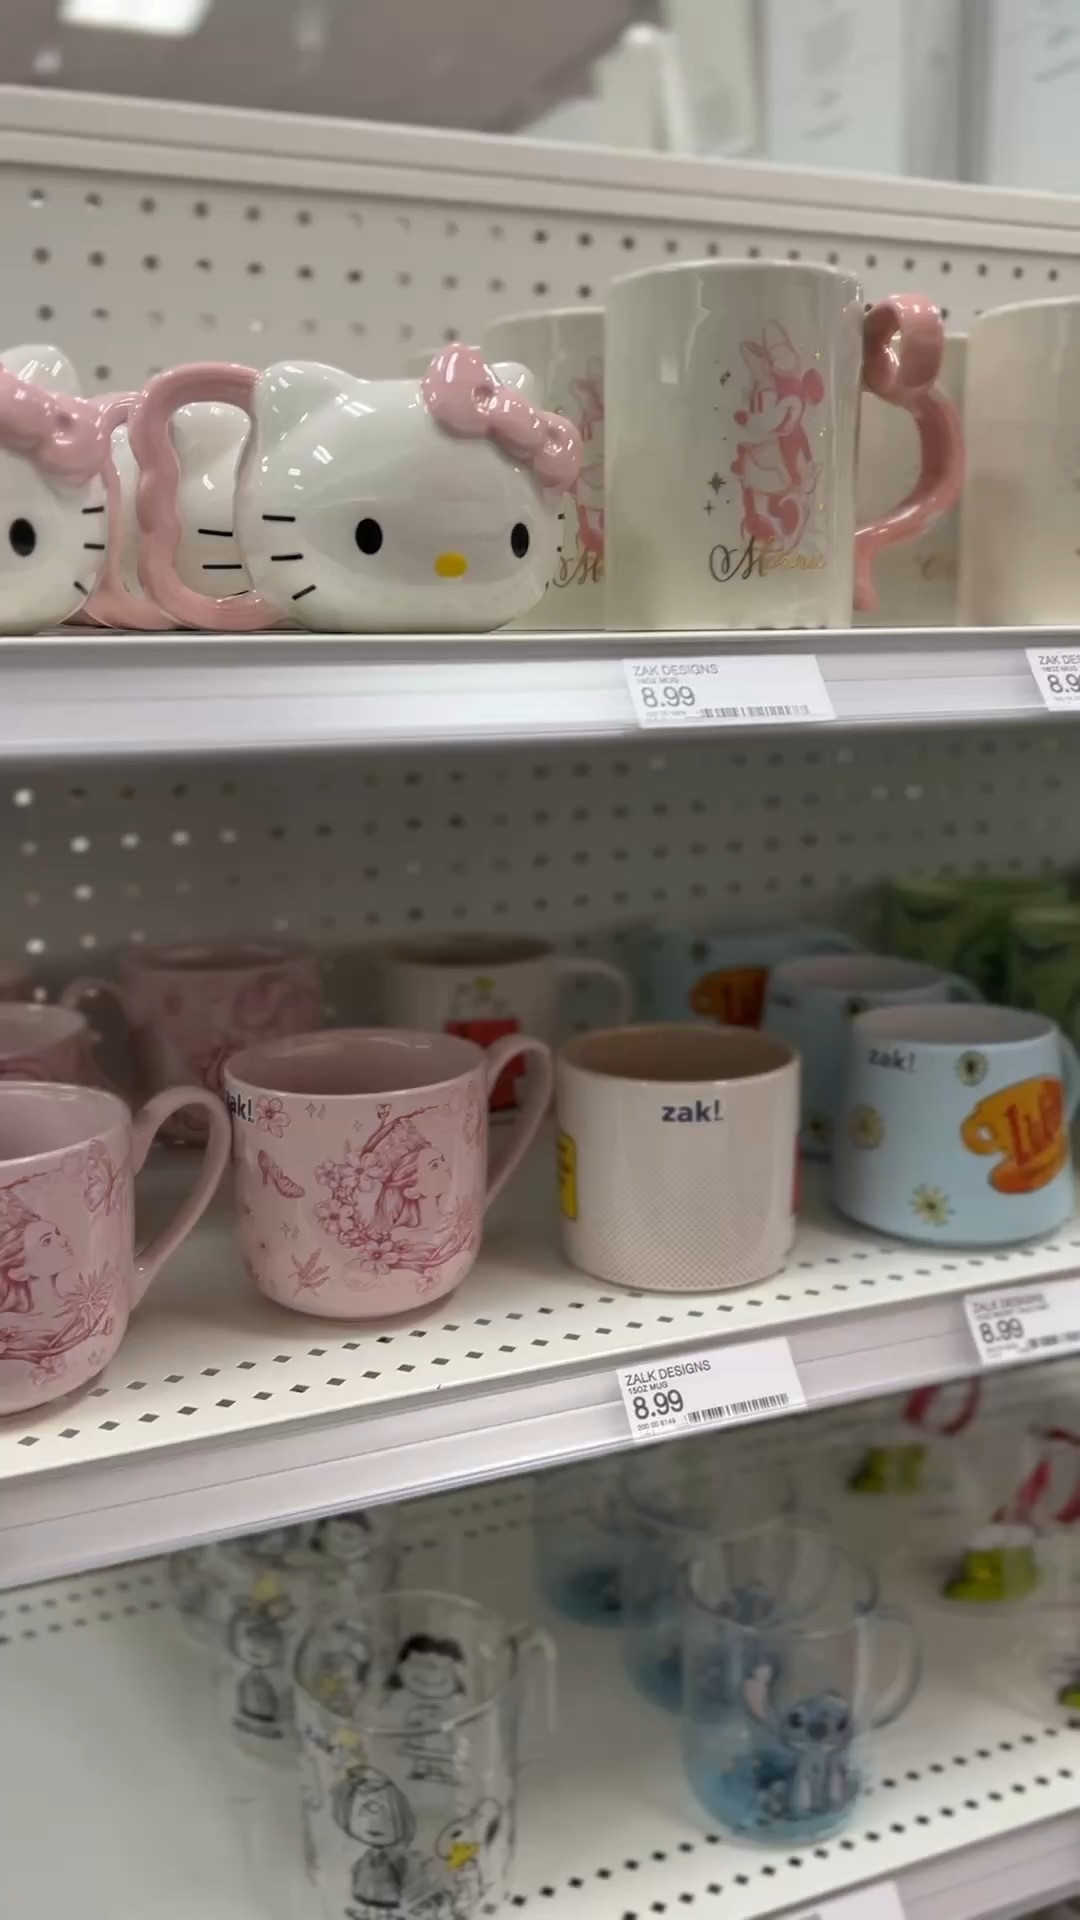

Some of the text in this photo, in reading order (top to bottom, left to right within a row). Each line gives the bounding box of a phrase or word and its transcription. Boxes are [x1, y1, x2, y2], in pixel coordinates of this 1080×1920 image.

[632, 663, 719, 676] ZAK DESIGNS
[1047, 673, 1080, 693] 8.9
[641, 685, 695, 708] 8.99
[662, 1099, 724, 1122] zak!
[980, 1318, 1024, 1344] 8.99
[625, 1359, 711, 1386] ZALK DESIGNS
[628, 1380, 668, 1395] 15OZ MUG
[633, 1389, 684, 1420] 8.99
